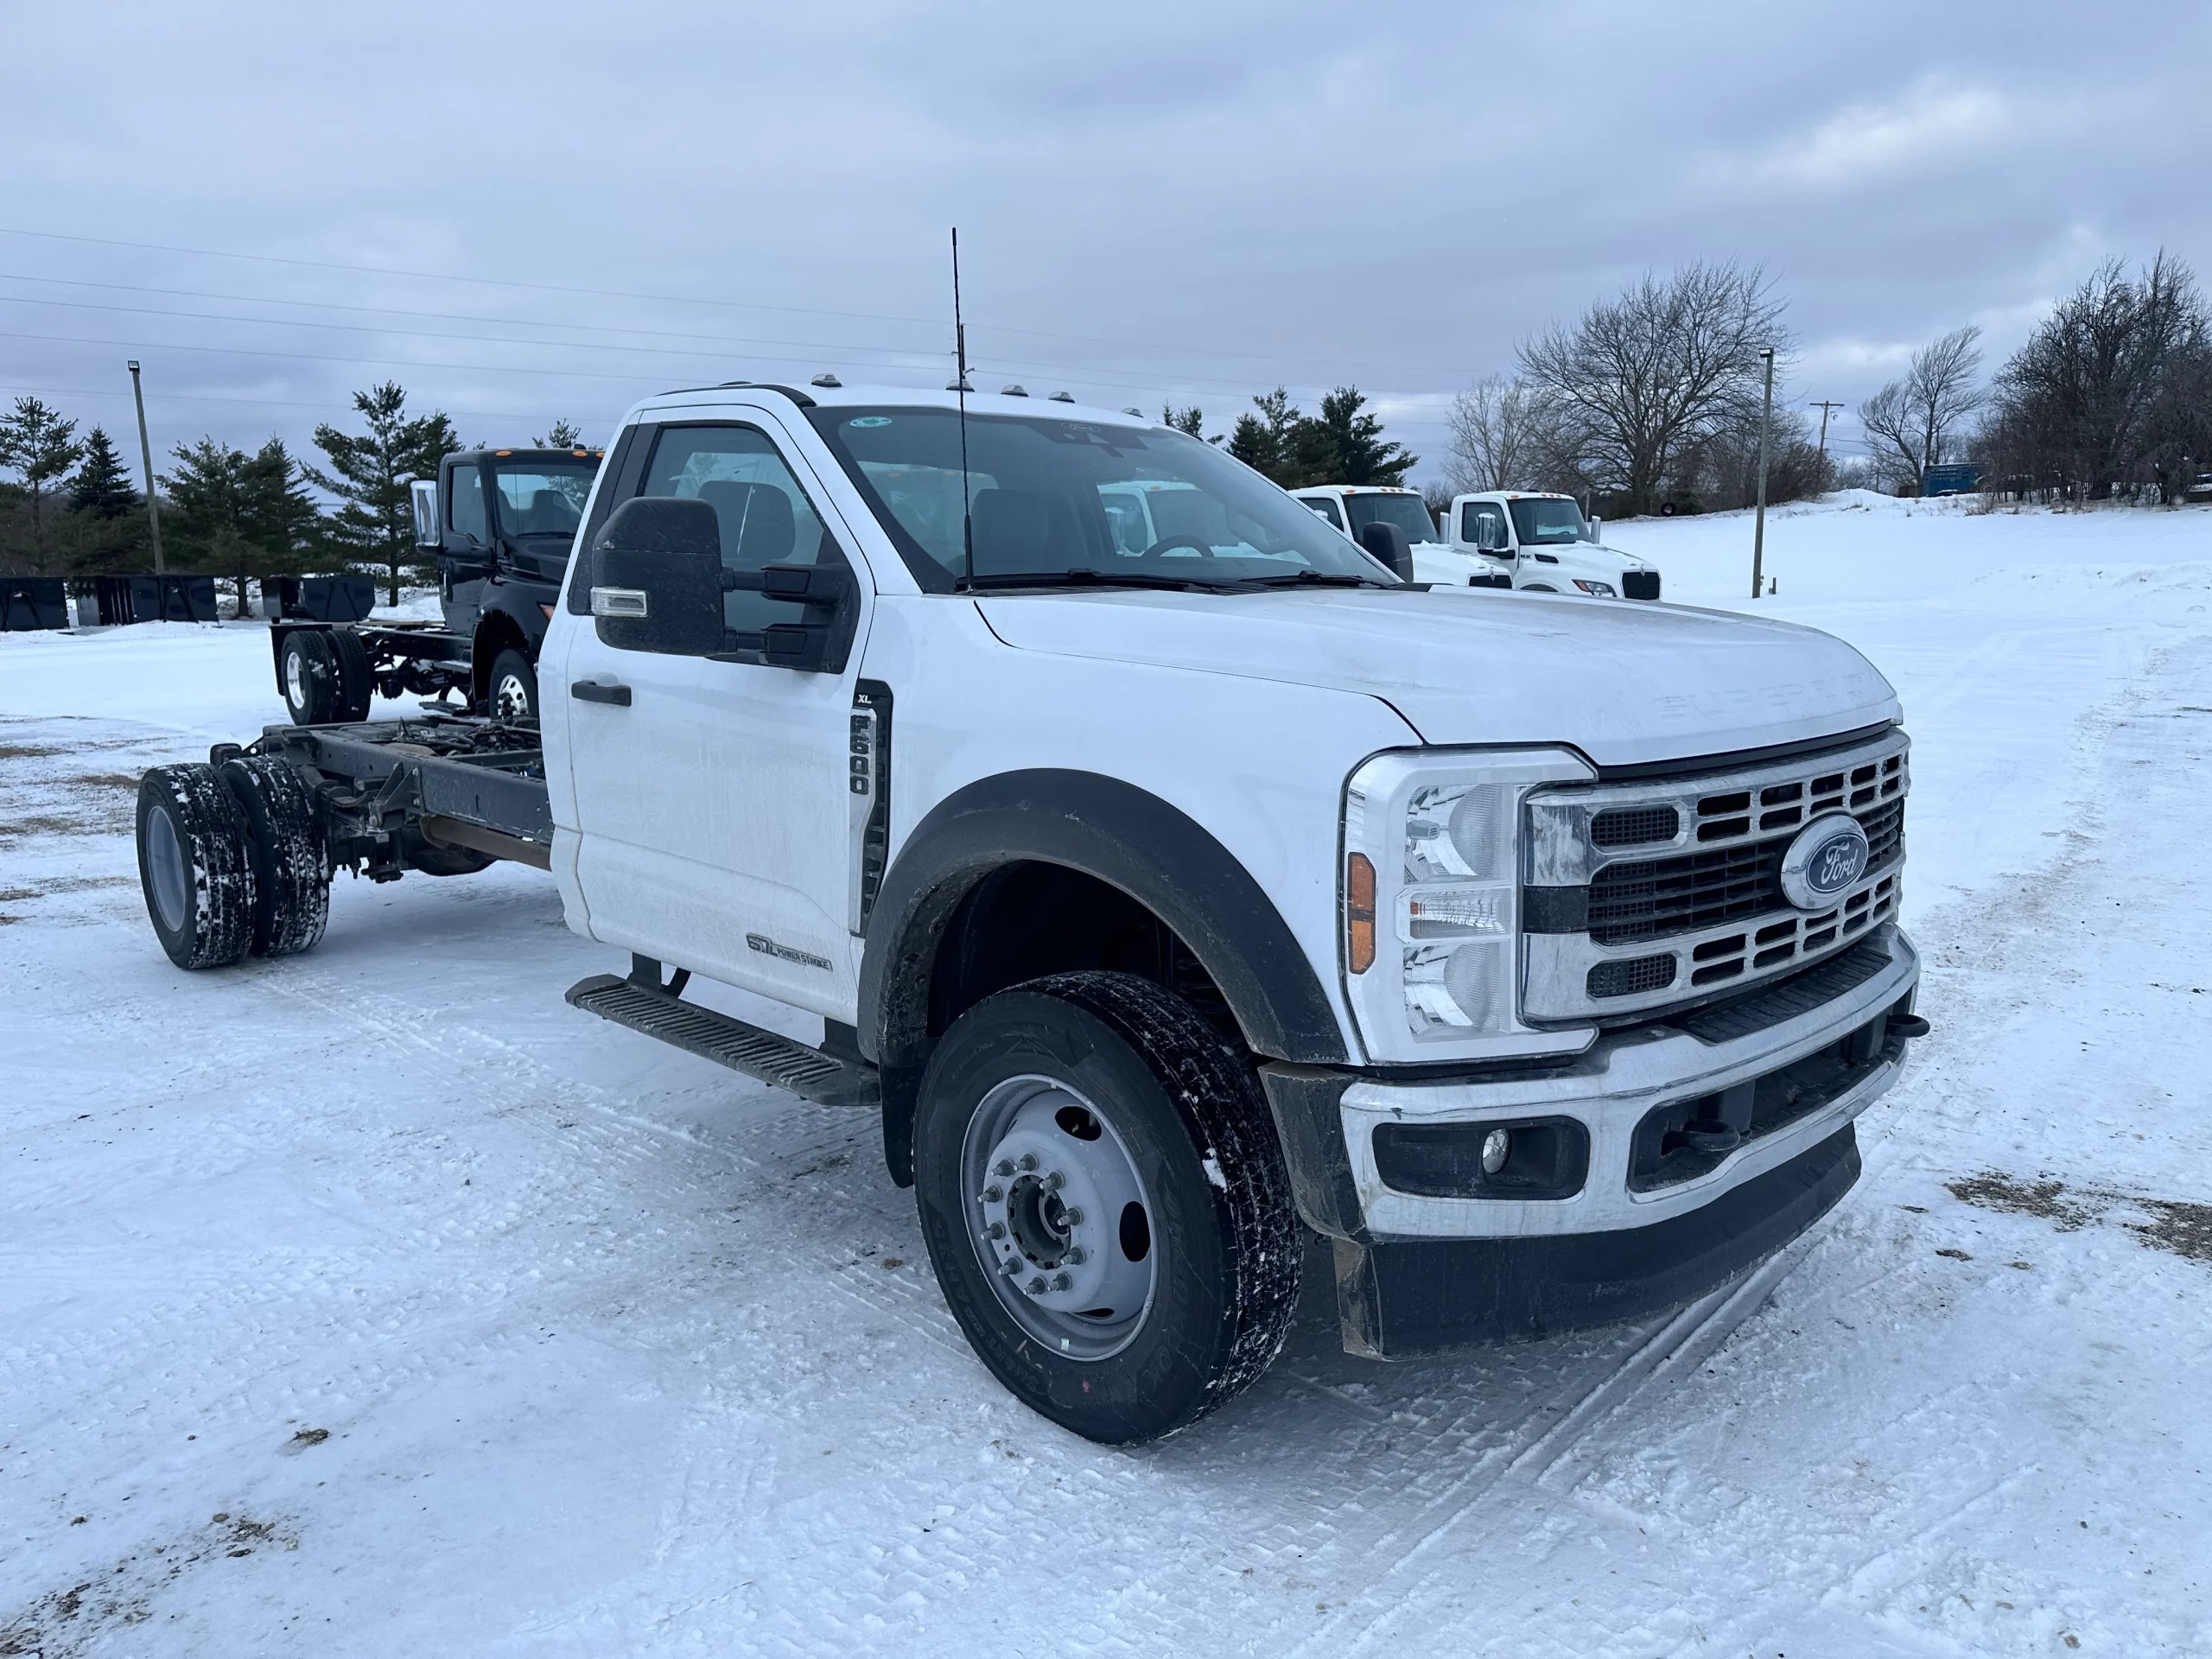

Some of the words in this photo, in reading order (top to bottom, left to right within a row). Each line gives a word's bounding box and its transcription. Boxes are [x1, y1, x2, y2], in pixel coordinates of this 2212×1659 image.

[858, 694, 872, 704] XL
[1821, 842, 1859, 885] Ford
[777, 947, 801, 962] POWER
[802, 955, 829, 969] STROKE
